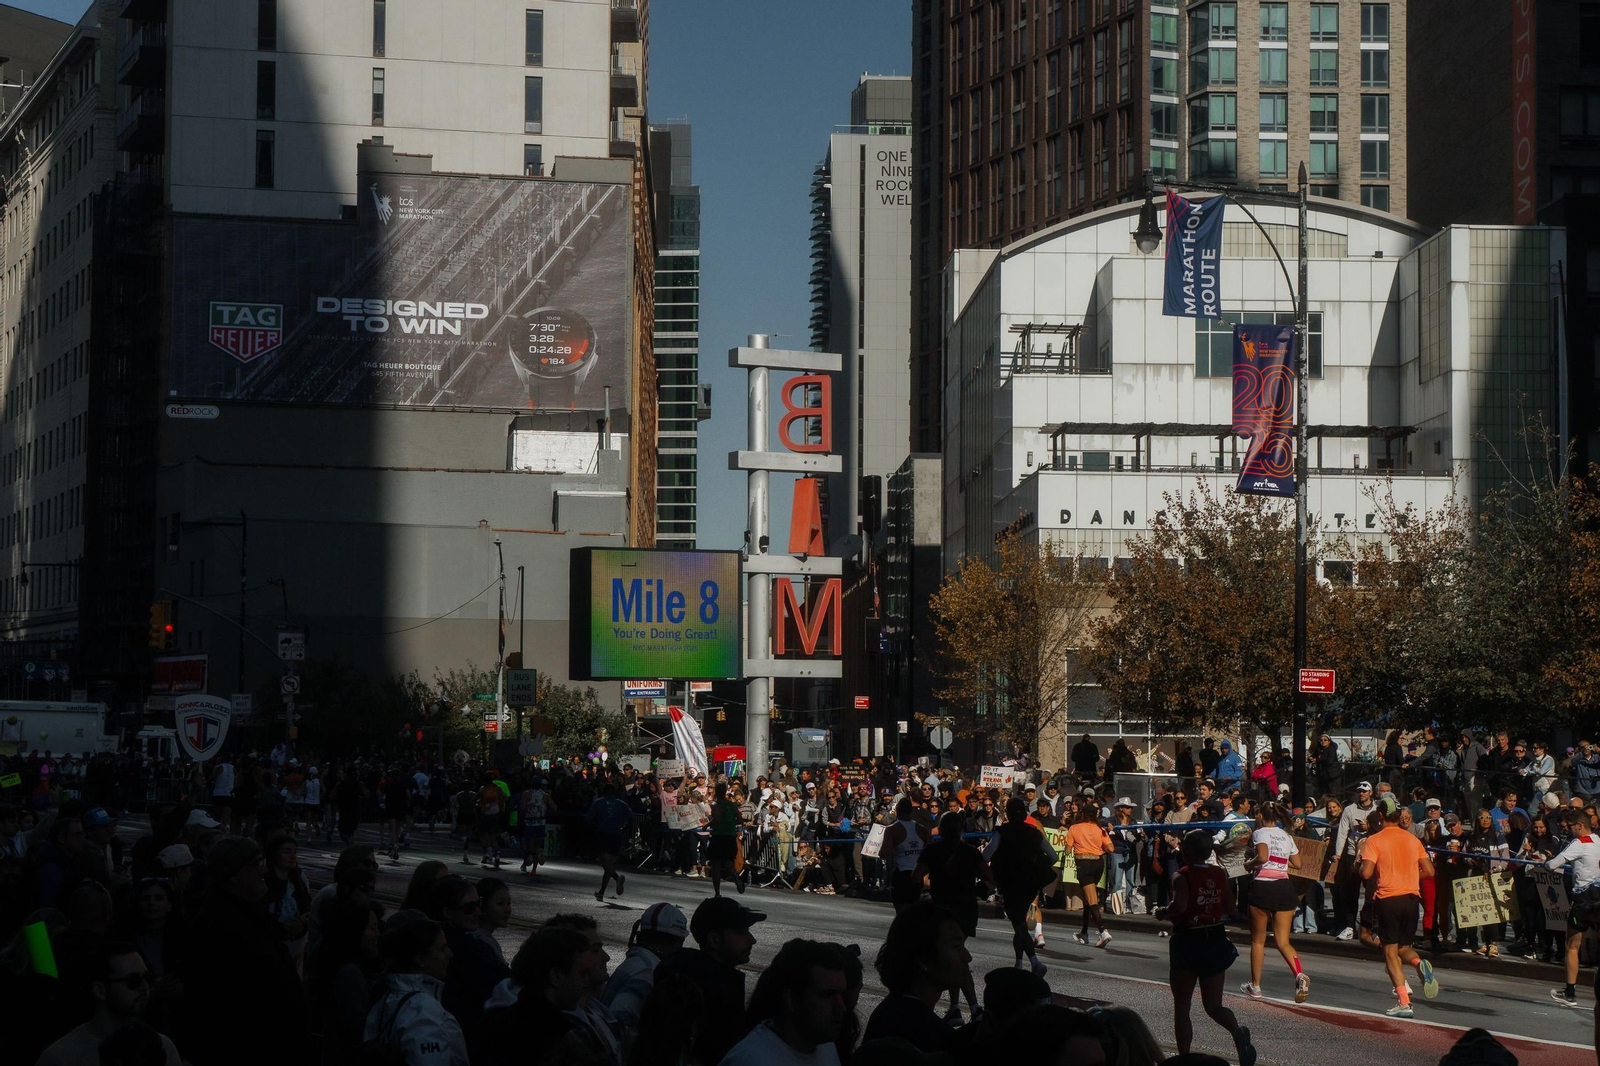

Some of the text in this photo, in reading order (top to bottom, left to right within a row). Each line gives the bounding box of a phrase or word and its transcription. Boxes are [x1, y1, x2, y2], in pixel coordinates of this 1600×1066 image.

[877, 151, 907, 162] ONE
[399, 197, 414, 206] tcs
[881, 194, 912, 205] WEL
[1183, 203, 1204, 315] MARATHON
[1201, 248, 1218, 317] ROUTE
[316, 296, 489, 319] DESIGNED
[216, 305, 276, 326] TAG
[343, 315, 462, 335] TO WIN
[213, 329, 278, 358] HEUER
[529, 334, 554, 343] 3.28
[529, 345, 572, 354] 0:24:28
[363, 361, 442, 371] TAG HEUER BOUTIQUE
[612, 578, 719, 624] Mile 8
[613, 628, 718, 641] You're Doing Great!
[627, 680, 663, 688] UNIFORMS
[1470, 903, 1493, 913] NYC
[420, 1042, 441, 1055] HH
